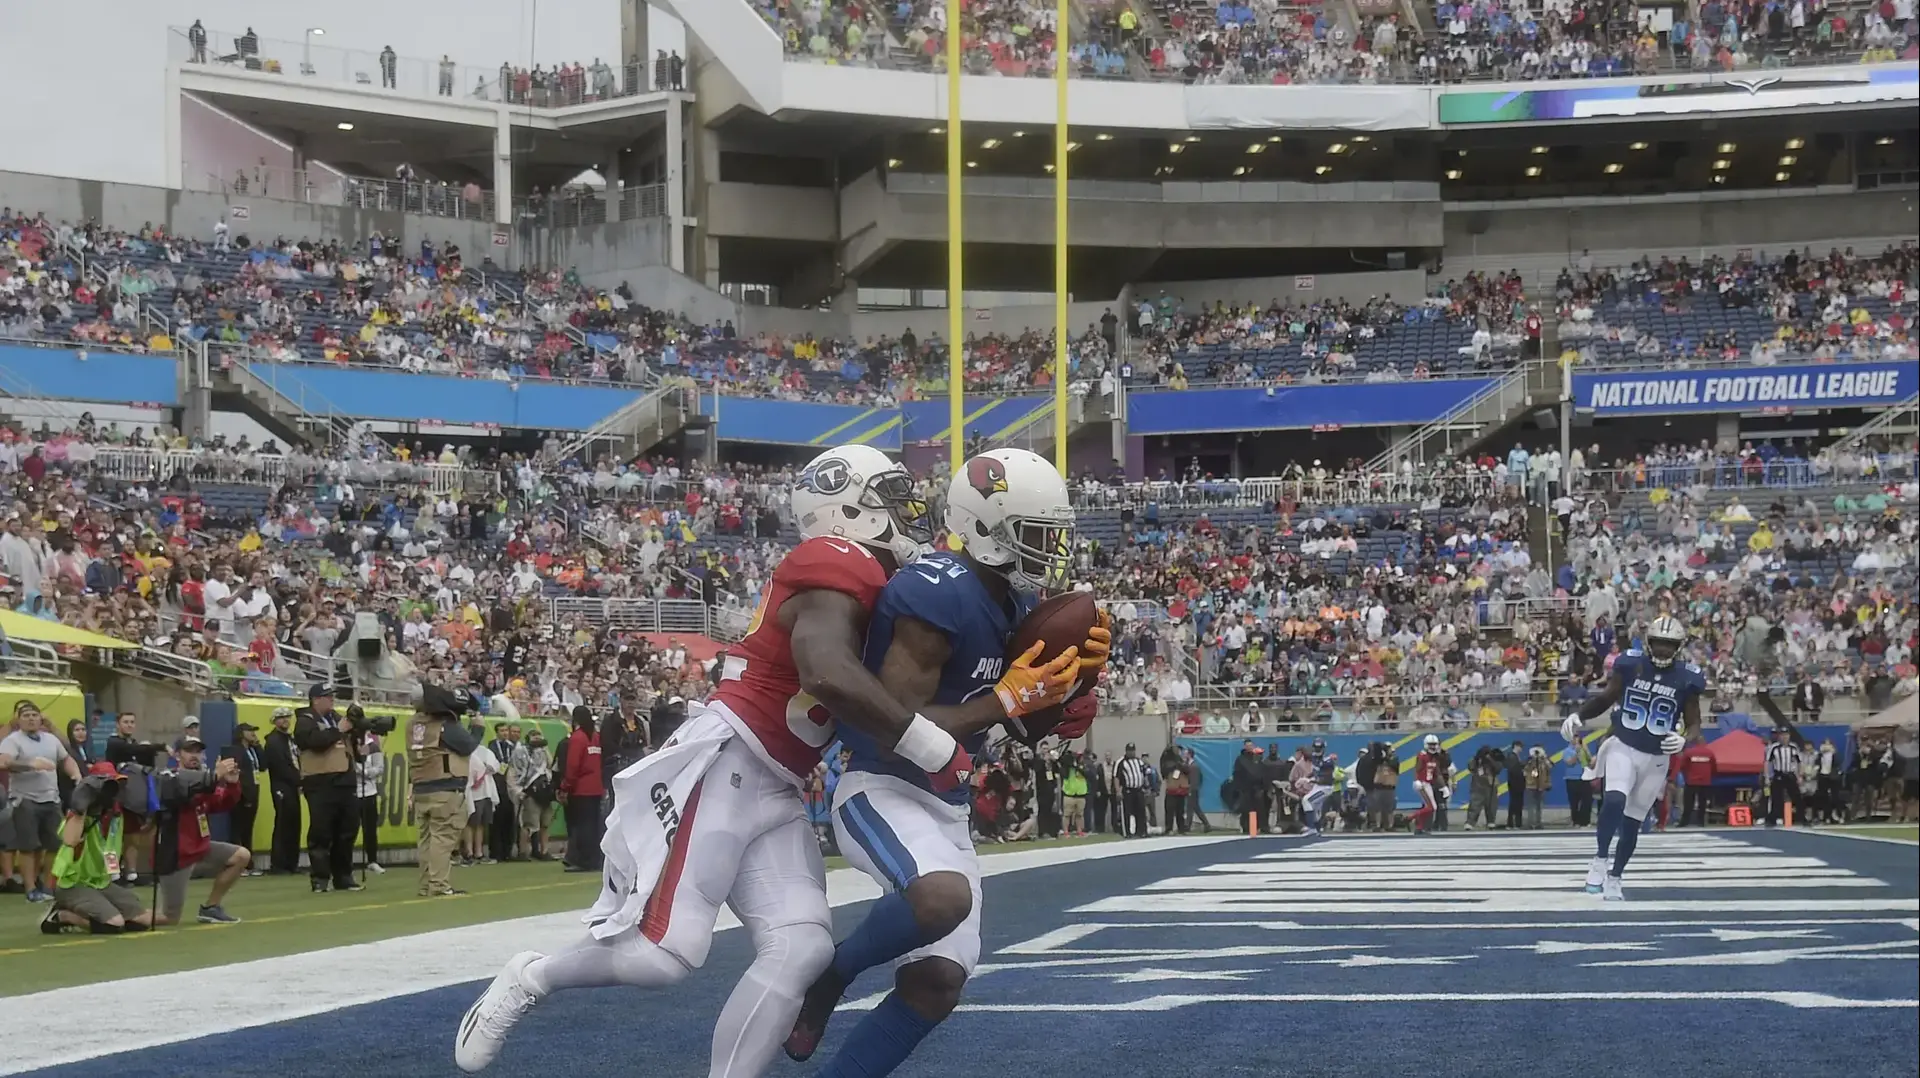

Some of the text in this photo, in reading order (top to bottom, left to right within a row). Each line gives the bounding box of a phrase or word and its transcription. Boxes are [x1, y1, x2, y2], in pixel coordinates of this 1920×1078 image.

[1591, 370, 1899, 408] NATIONAL FOOTBALL LEAGUE
[971, 657, 1003, 680] PRO
[1633, 679, 1676, 697] PRO BOWL
[1621, 687, 1678, 735] 58
[1734, 809, 1747, 825] G
